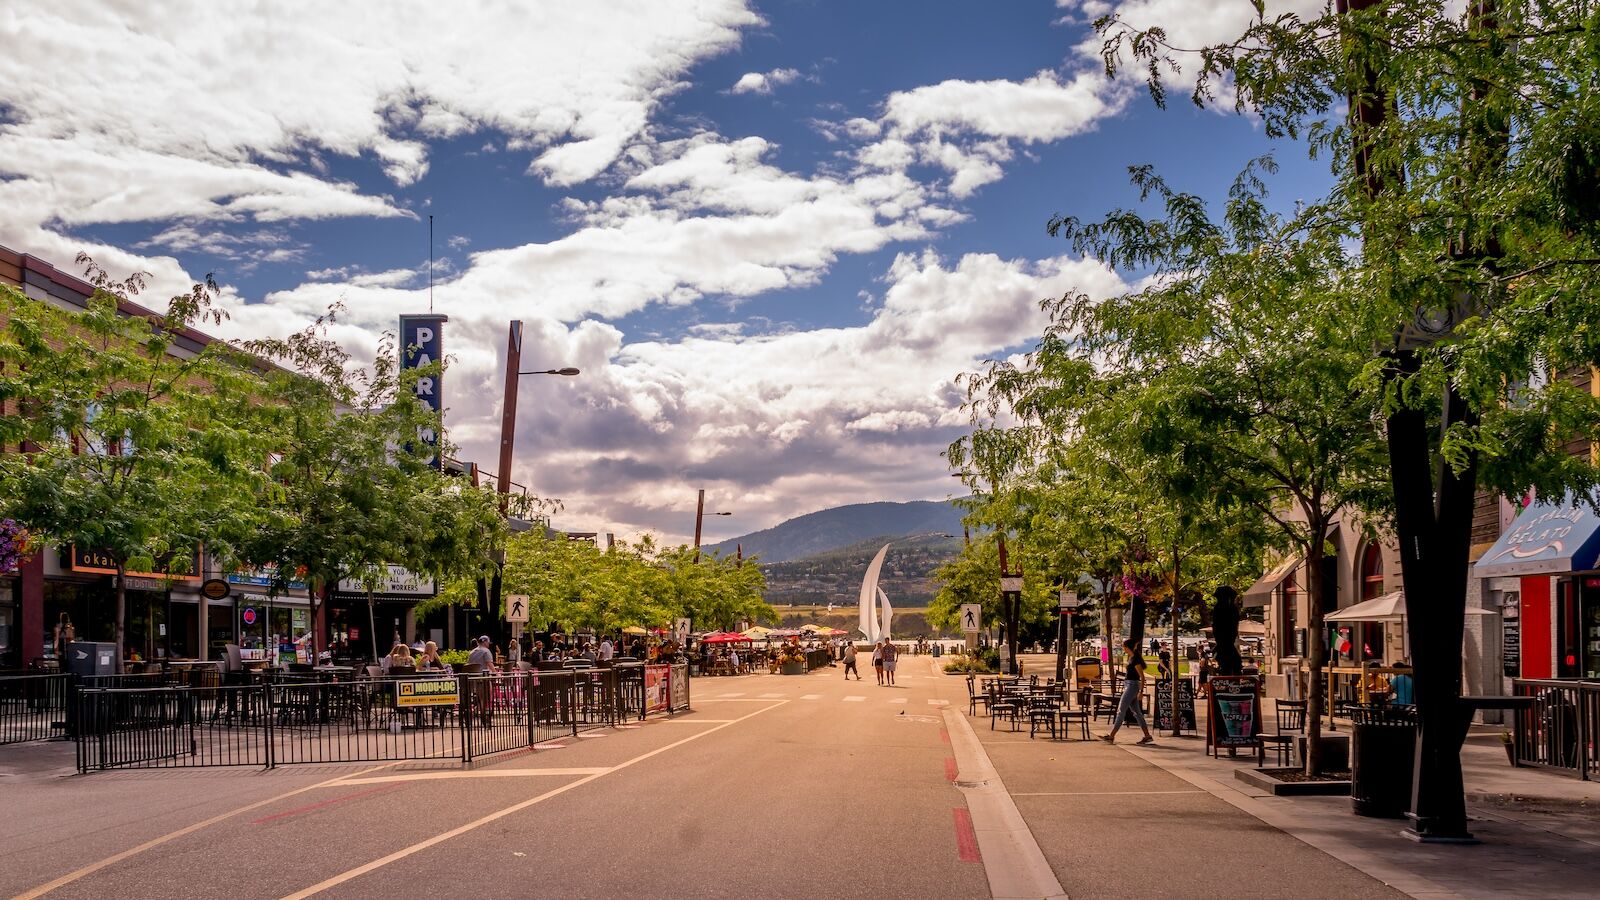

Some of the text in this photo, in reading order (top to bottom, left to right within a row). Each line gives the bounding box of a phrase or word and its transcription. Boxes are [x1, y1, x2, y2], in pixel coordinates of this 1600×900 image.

[1507, 525, 1572, 545] GELATO
[393, 568, 405, 576] YOU
[391, 584, 418, 592] WORKERS
